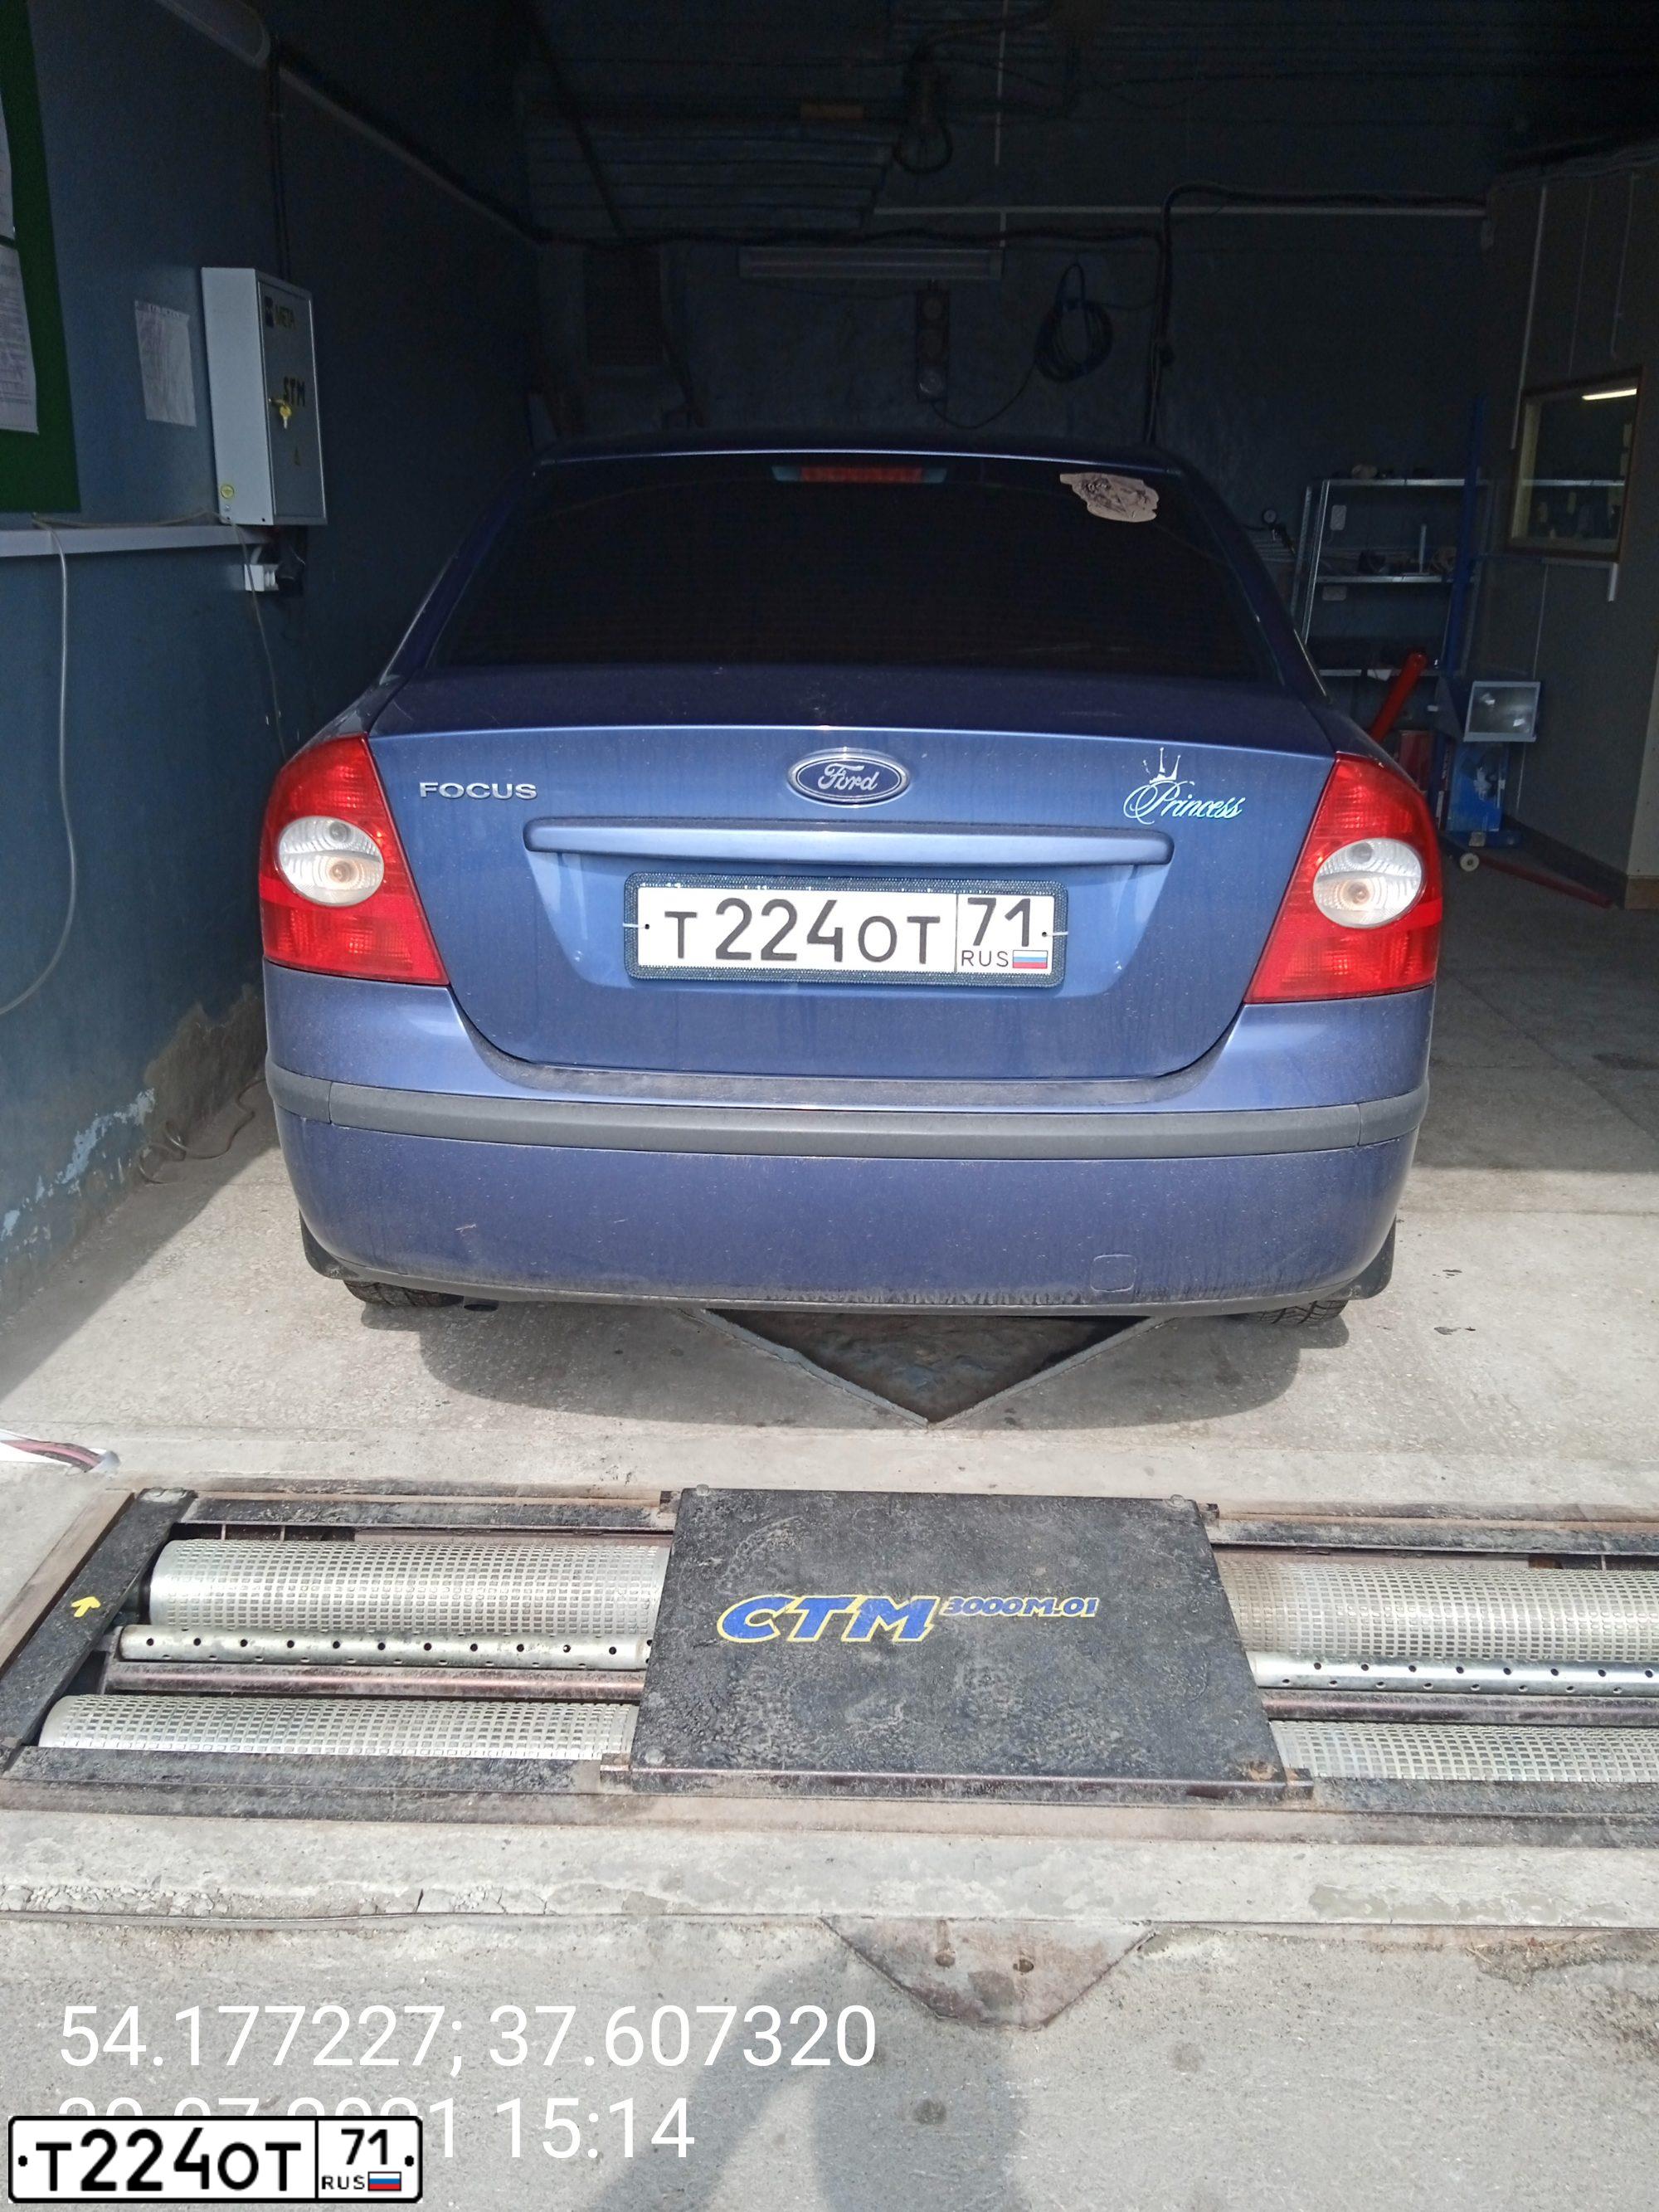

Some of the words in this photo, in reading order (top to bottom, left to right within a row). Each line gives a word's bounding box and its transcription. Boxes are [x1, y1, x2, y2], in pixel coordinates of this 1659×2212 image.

[419, 782, 538, 800] FOCUS
[817, 763, 880, 791] Ford
[1123, 780, 1246, 825] Princess
[966, 897, 1032, 948] 71
[961, 949, 1010, 968] RUS
